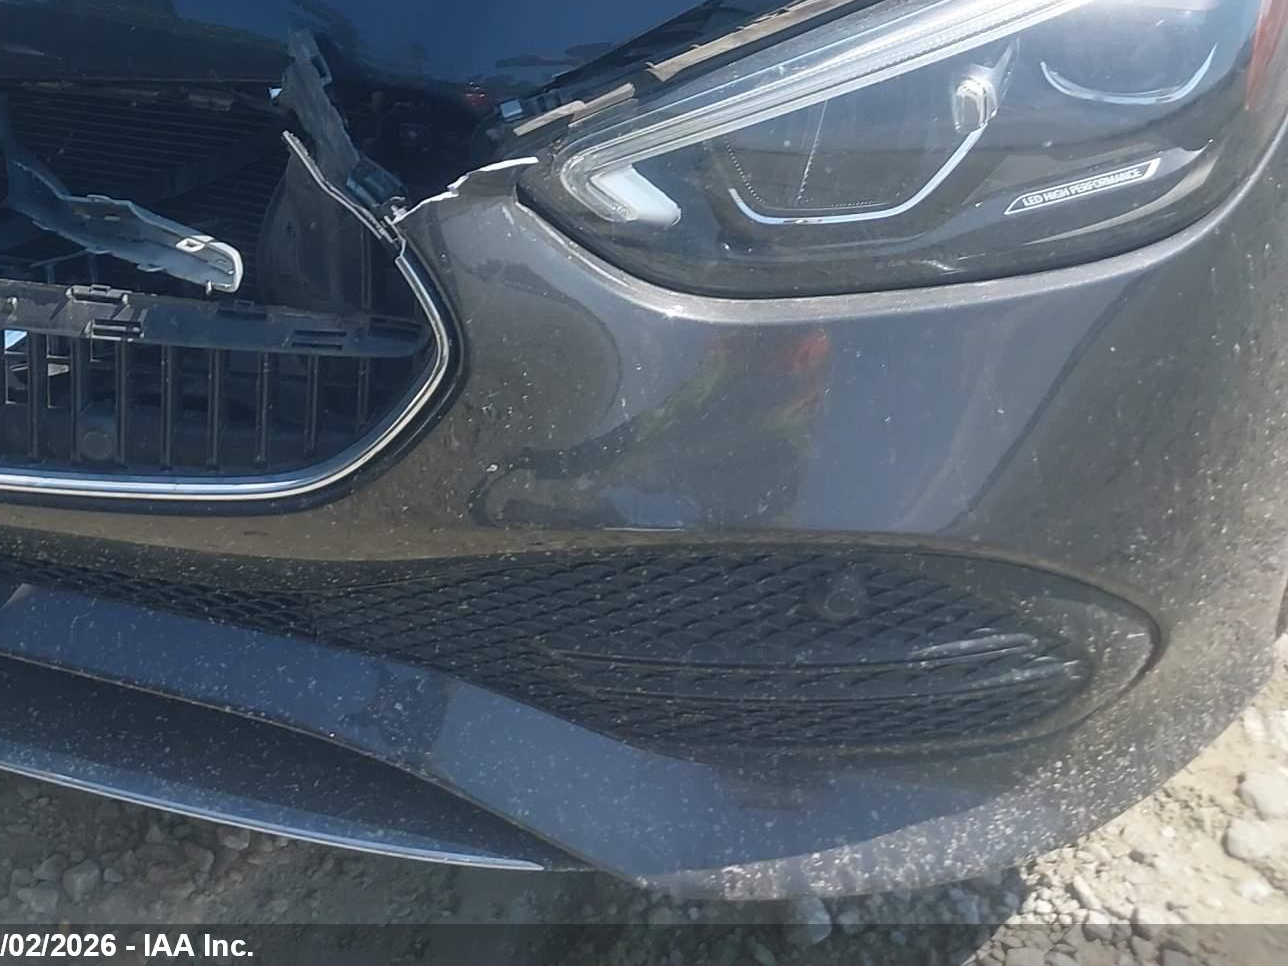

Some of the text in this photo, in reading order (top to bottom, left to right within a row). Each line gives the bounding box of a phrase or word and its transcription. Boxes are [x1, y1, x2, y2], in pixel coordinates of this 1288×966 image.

[1022, 168, 1142, 207] LED HIGH PERFORMANCE
